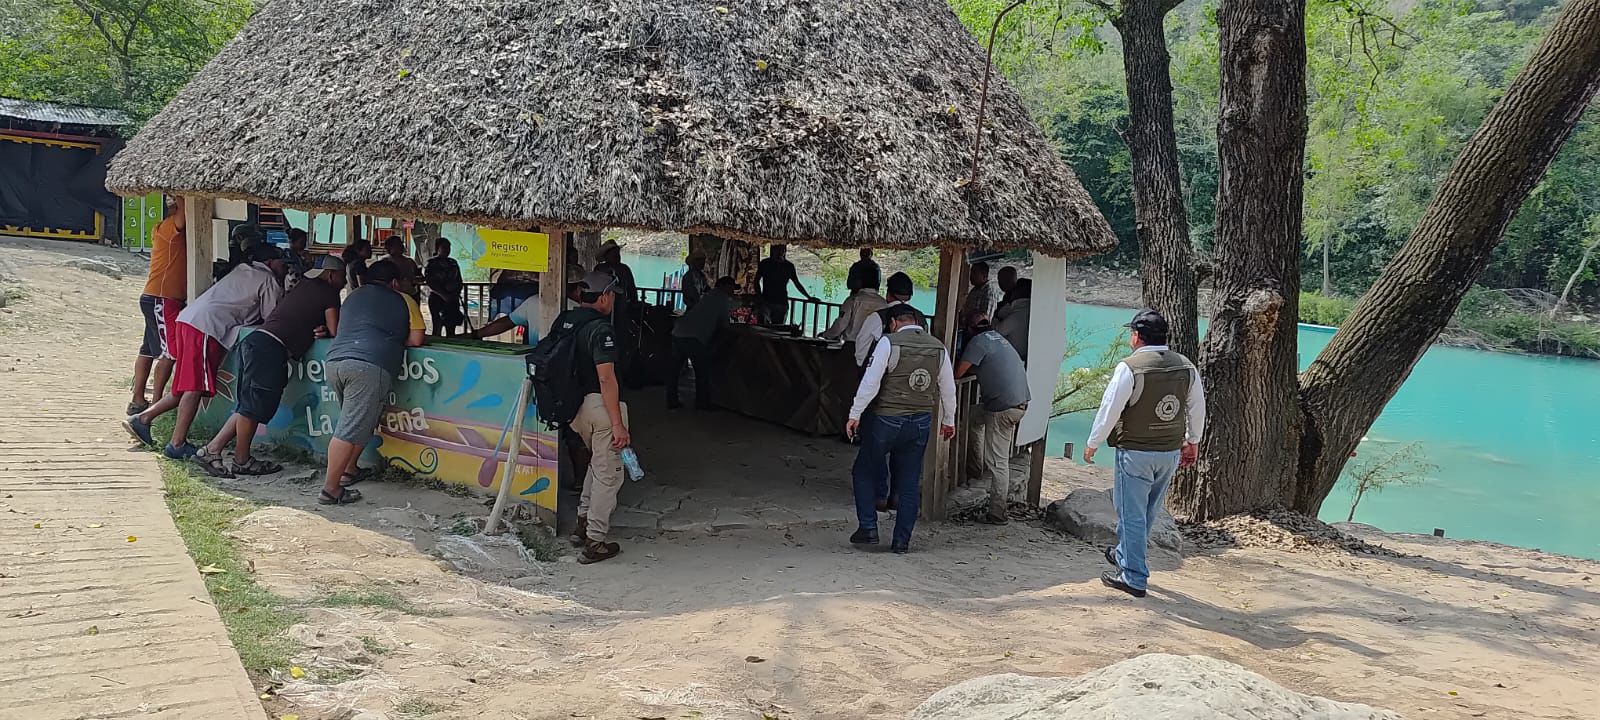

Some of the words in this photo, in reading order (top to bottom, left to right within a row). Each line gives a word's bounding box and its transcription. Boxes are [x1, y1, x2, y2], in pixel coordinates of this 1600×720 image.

[148, 207, 157, 218] 6
[130, 217, 137, 227] 3
[491, 241, 528, 252] Registro
[305, 405, 333, 437] La
